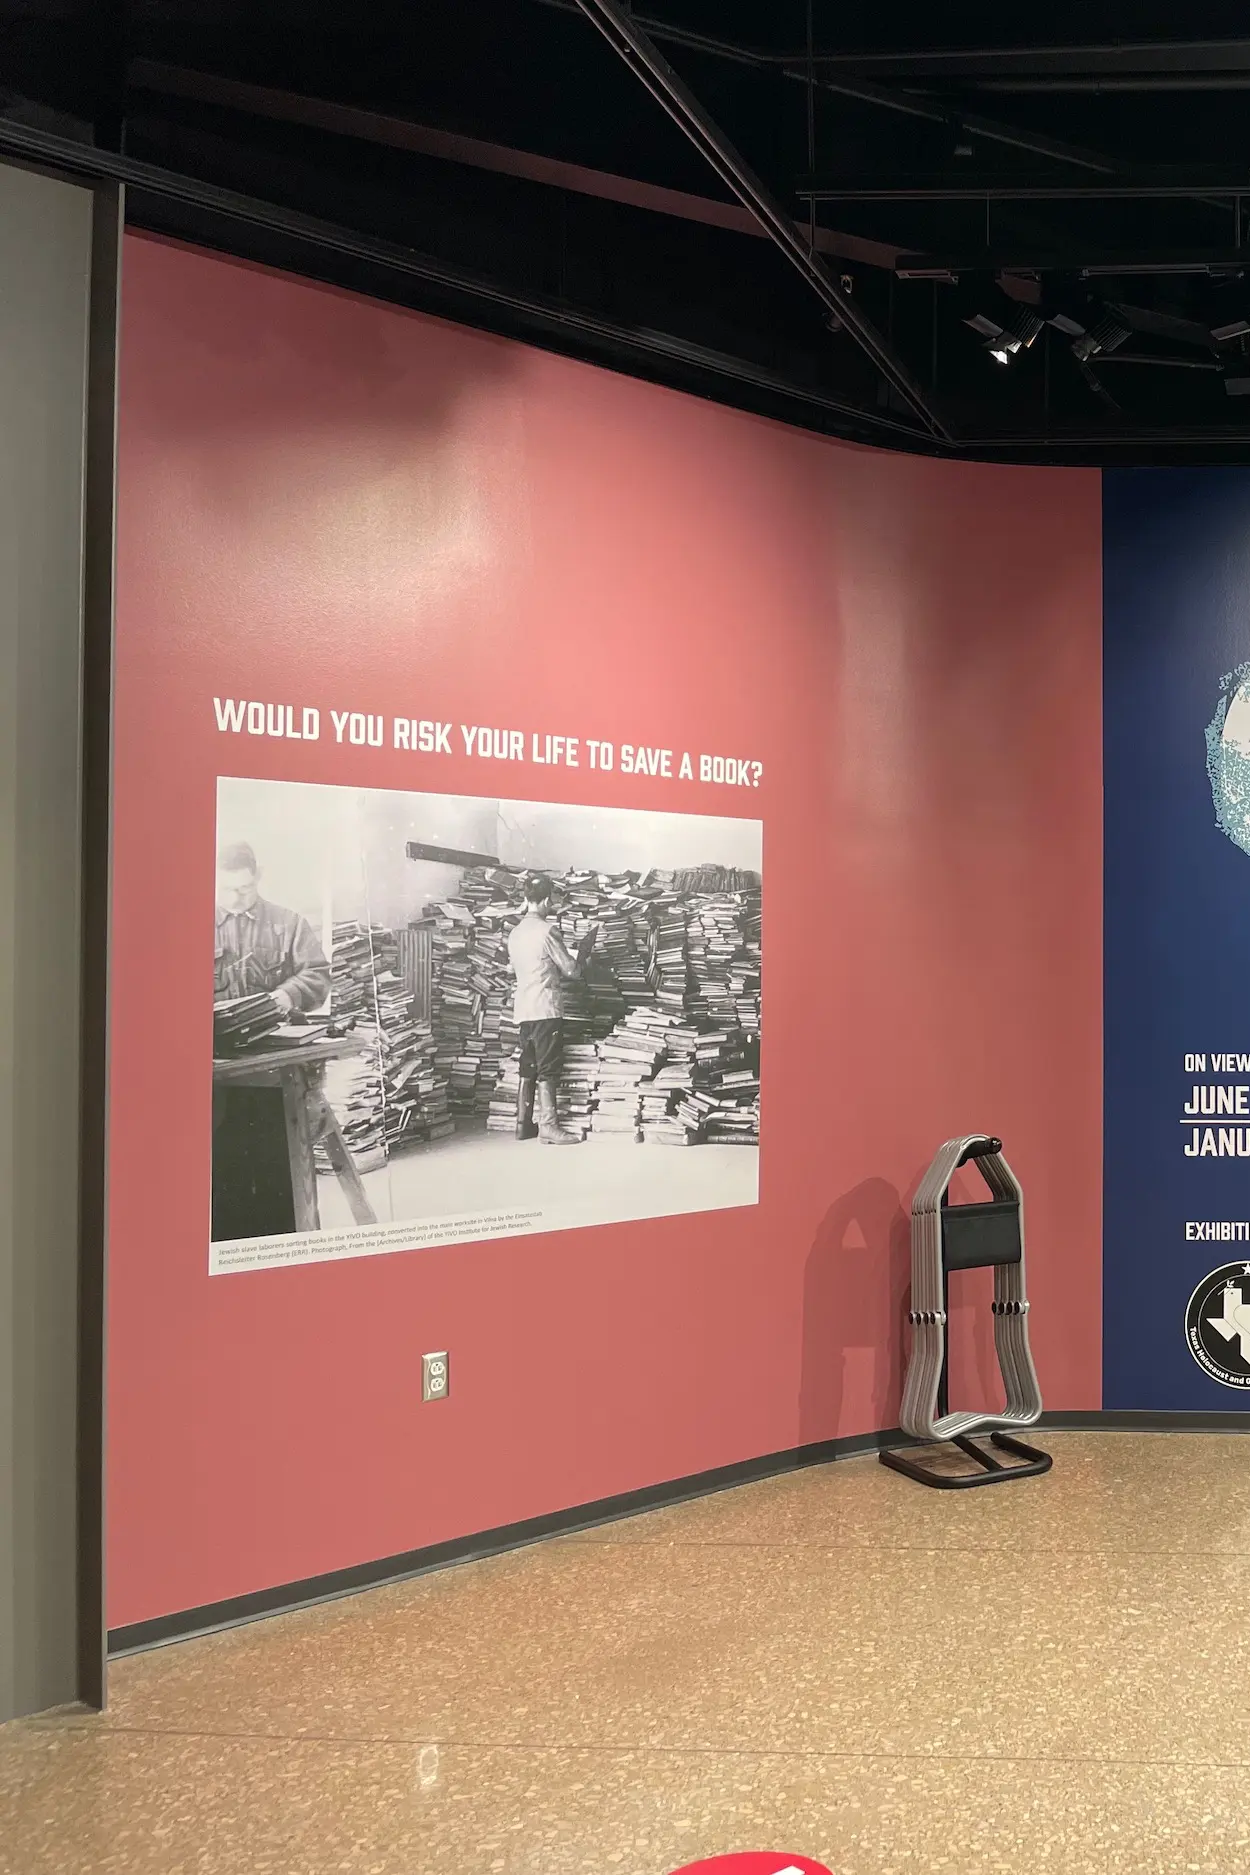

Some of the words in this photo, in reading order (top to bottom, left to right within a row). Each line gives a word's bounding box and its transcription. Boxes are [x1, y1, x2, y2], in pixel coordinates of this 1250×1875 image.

[213, 697, 320, 741] WOULD
[330, 711, 383, 747] YOU
[393, 717, 452, 754] RISK
[461, 725, 524, 761] YOUR
[532, 734, 579, 768] LIFE
[586, 739, 613, 770] TO
[620, 744, 673, 778] SAVE
[679, 752, 693, 780] A
[699, 755, 763, 788] BOOK?
[1184, 1053, 1206, 1072] ON
[1184, 1085, 1250, 1115] JUNE
[1189, 1326, 1200, 1351] Texas
[1197, 1349, 1229, 1380] Holocaust
[1229, 1376, 1245, 1385] and
